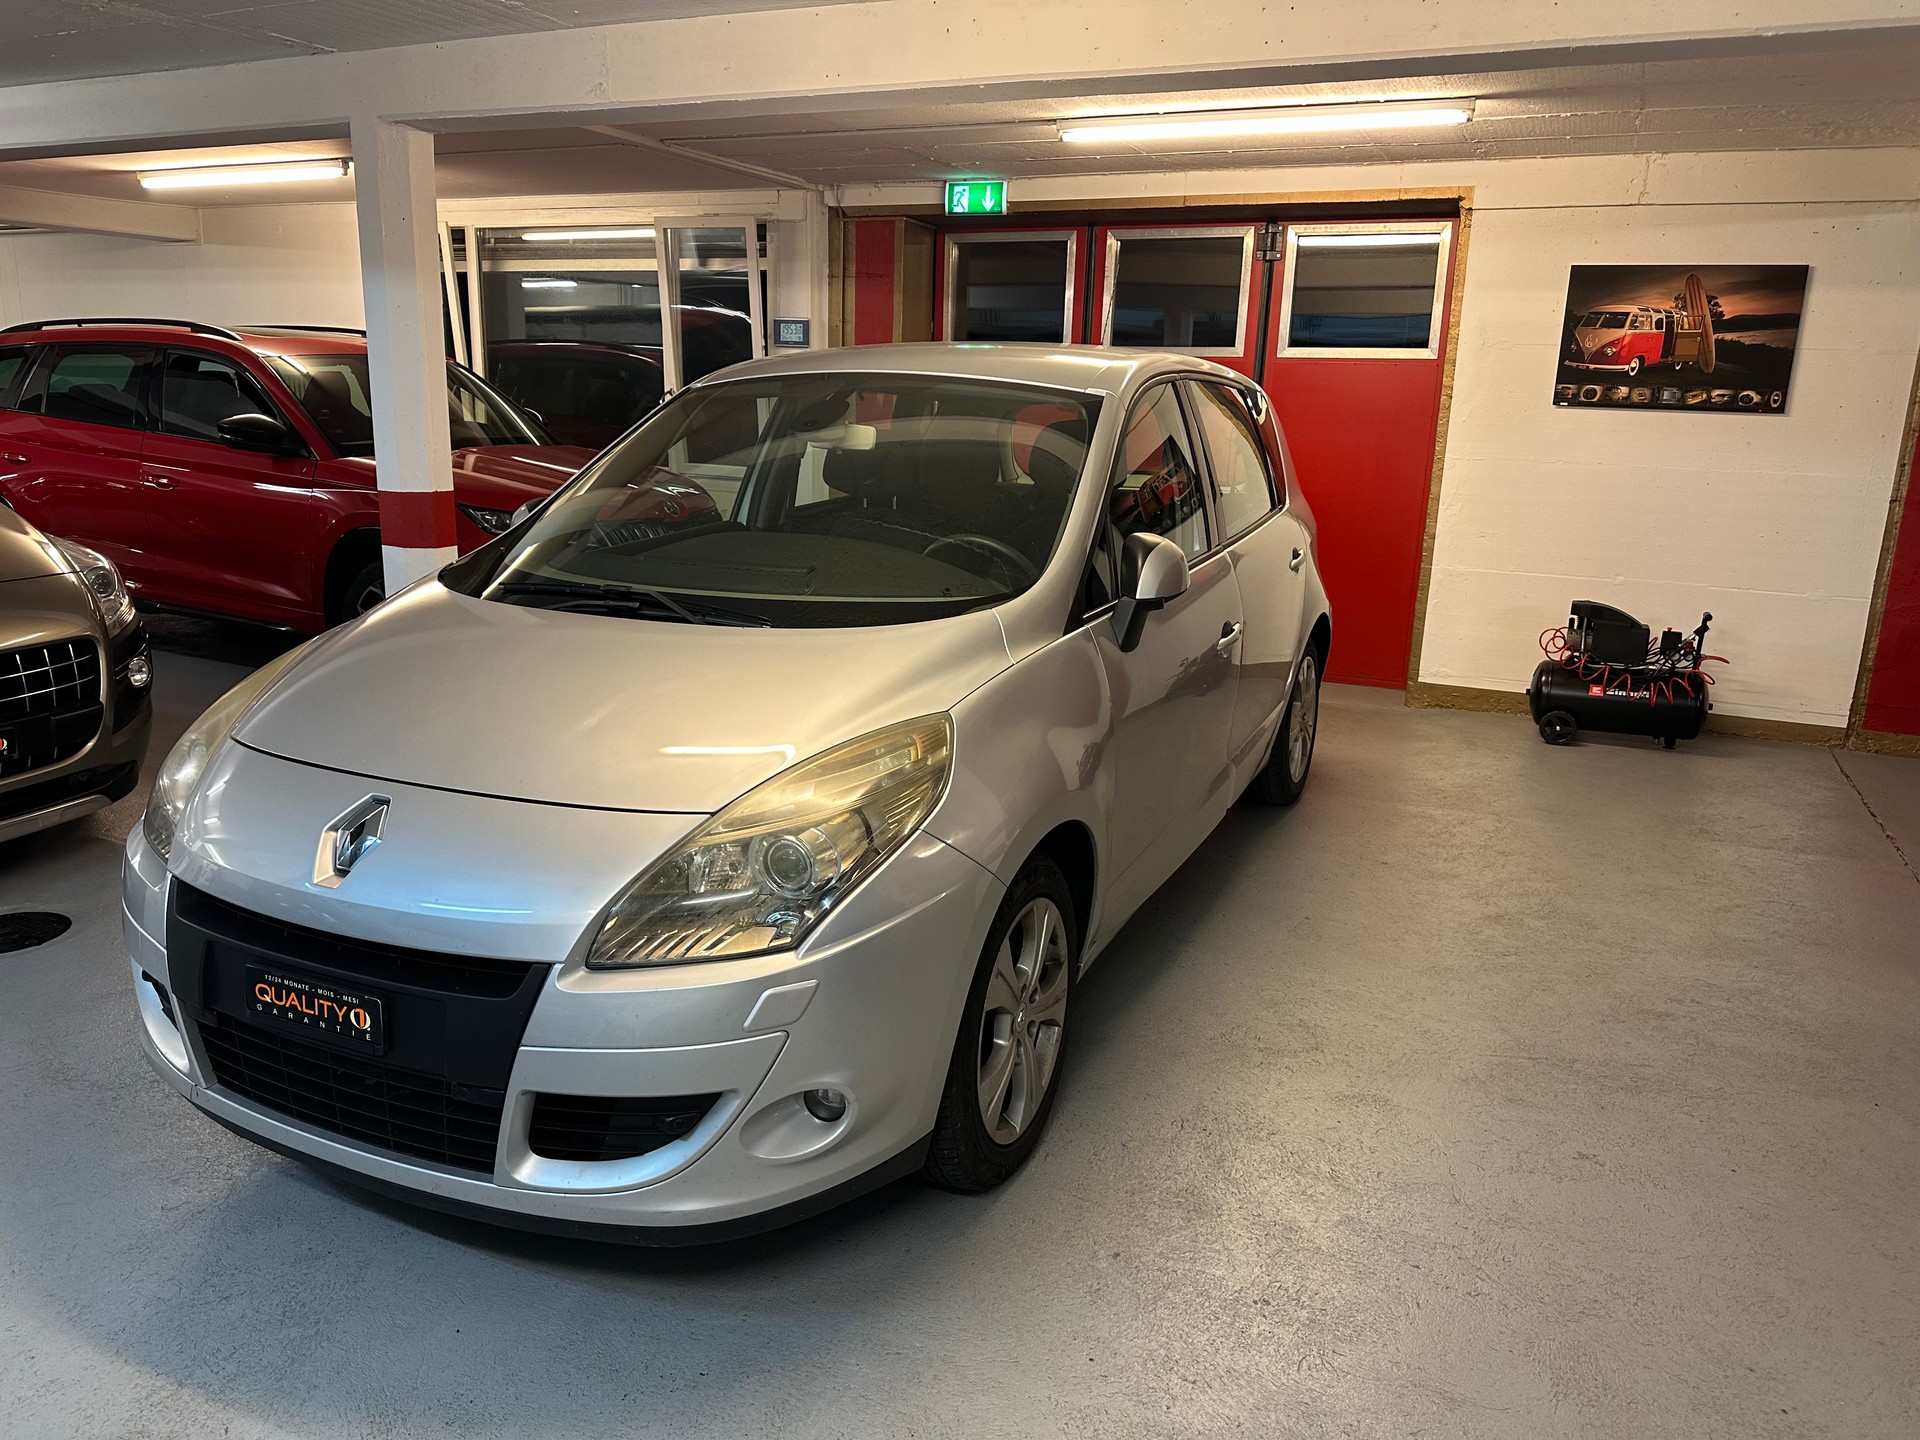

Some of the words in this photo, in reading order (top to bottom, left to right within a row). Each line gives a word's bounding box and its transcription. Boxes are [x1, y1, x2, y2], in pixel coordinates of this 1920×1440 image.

[255, 983, 348, 1023] QUALITY
[264, 974, 282, 984] 12/24
[283, 979, 310, 991] MONATE
[317, 988, 335, 998] MOIS
[342, 994, 359, 1005] MESI
[256, 1003, 371, 1041] GARANTIE
